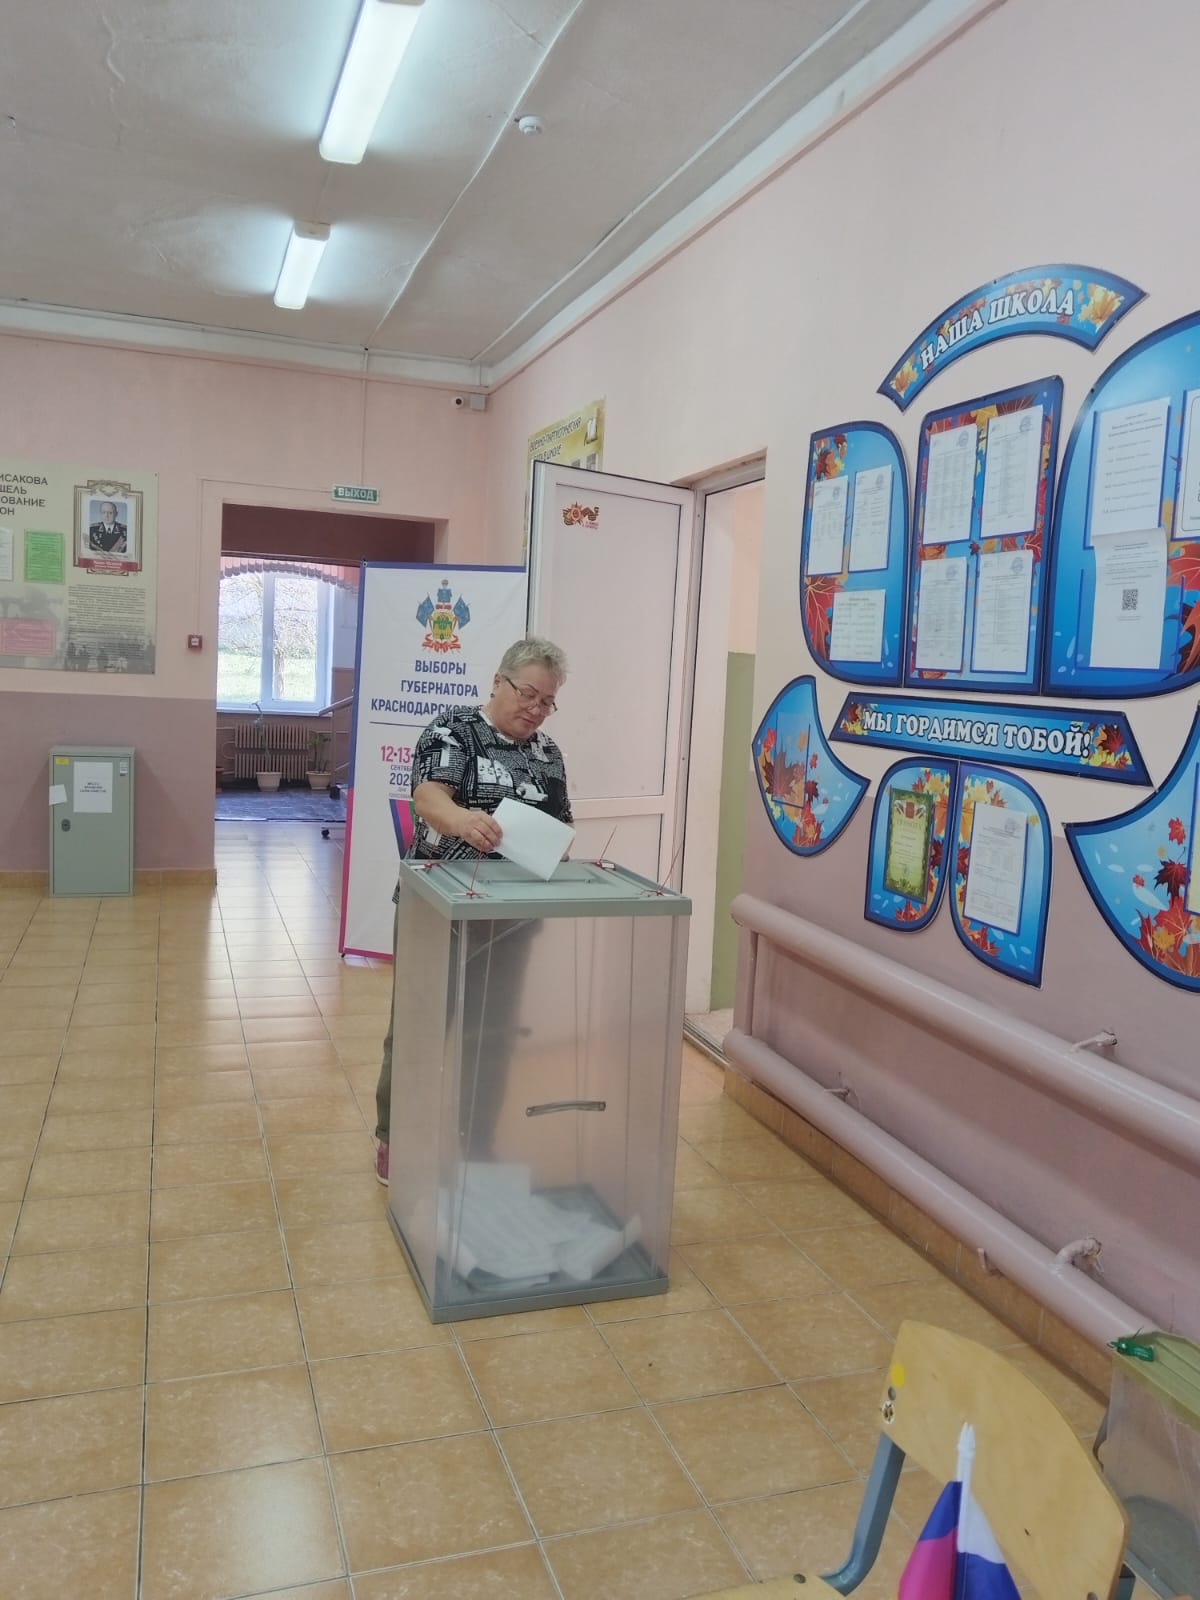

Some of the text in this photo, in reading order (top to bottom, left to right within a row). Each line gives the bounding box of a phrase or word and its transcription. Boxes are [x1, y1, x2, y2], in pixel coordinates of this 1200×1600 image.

[920, 287, 1075, 370] НАША ШКОЛА
[337, 487, 375, 500] ВЫХОД
[414, 660, 467, 675] ВЫБОРЫ
[400, 680, 479, 698] ГУБЕРНАТОРА
[862, 709, 1093, 758] МЫ ГОРДИМСЯ ТОБОЙ!
